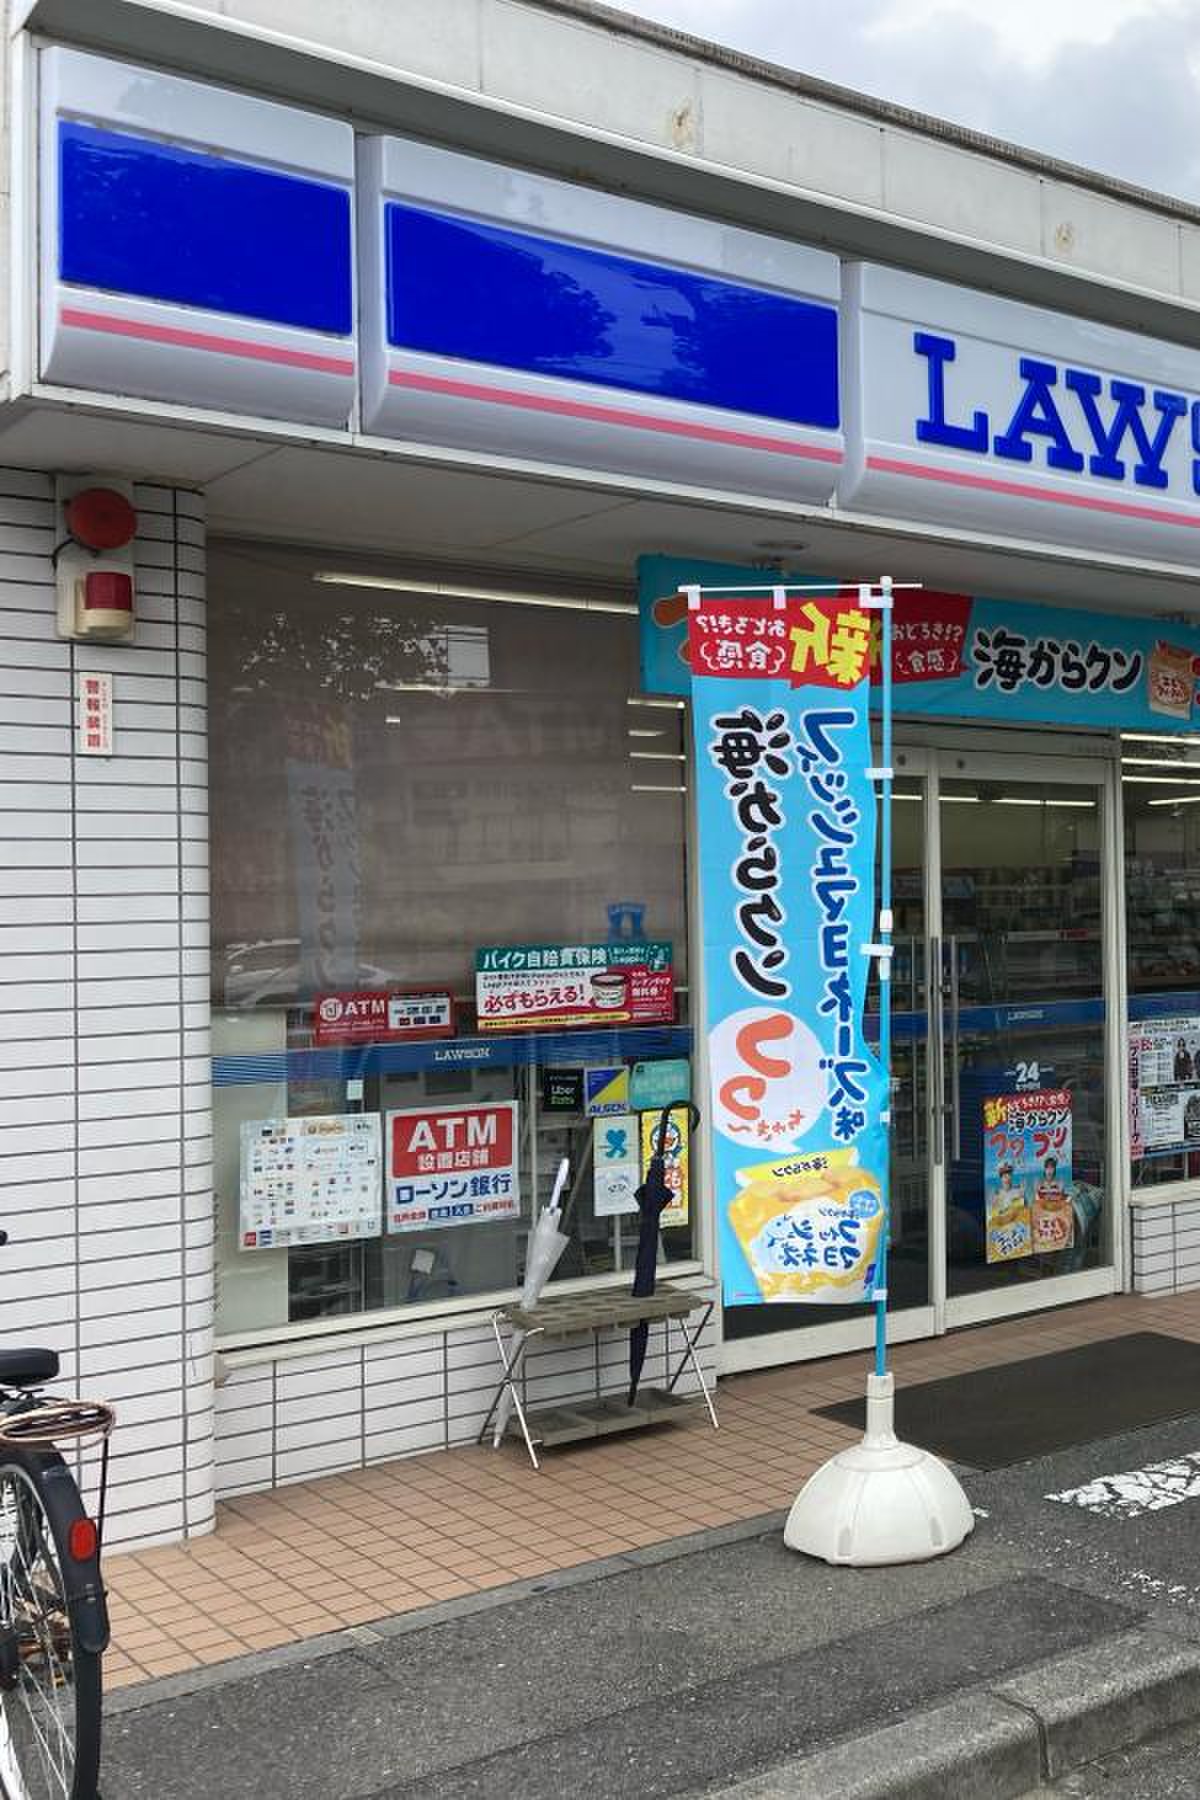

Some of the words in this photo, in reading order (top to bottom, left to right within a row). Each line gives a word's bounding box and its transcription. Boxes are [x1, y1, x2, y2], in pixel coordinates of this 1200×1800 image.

[973, 627, 1141, 691] 海からクン
[345, 1000, 384, 1016] ATM
[1016, 1061, 1039, 1082] 24
[408, 1113, 497, 1153] ATM
[396, 1173, 513, 1204] ローソン銀行
